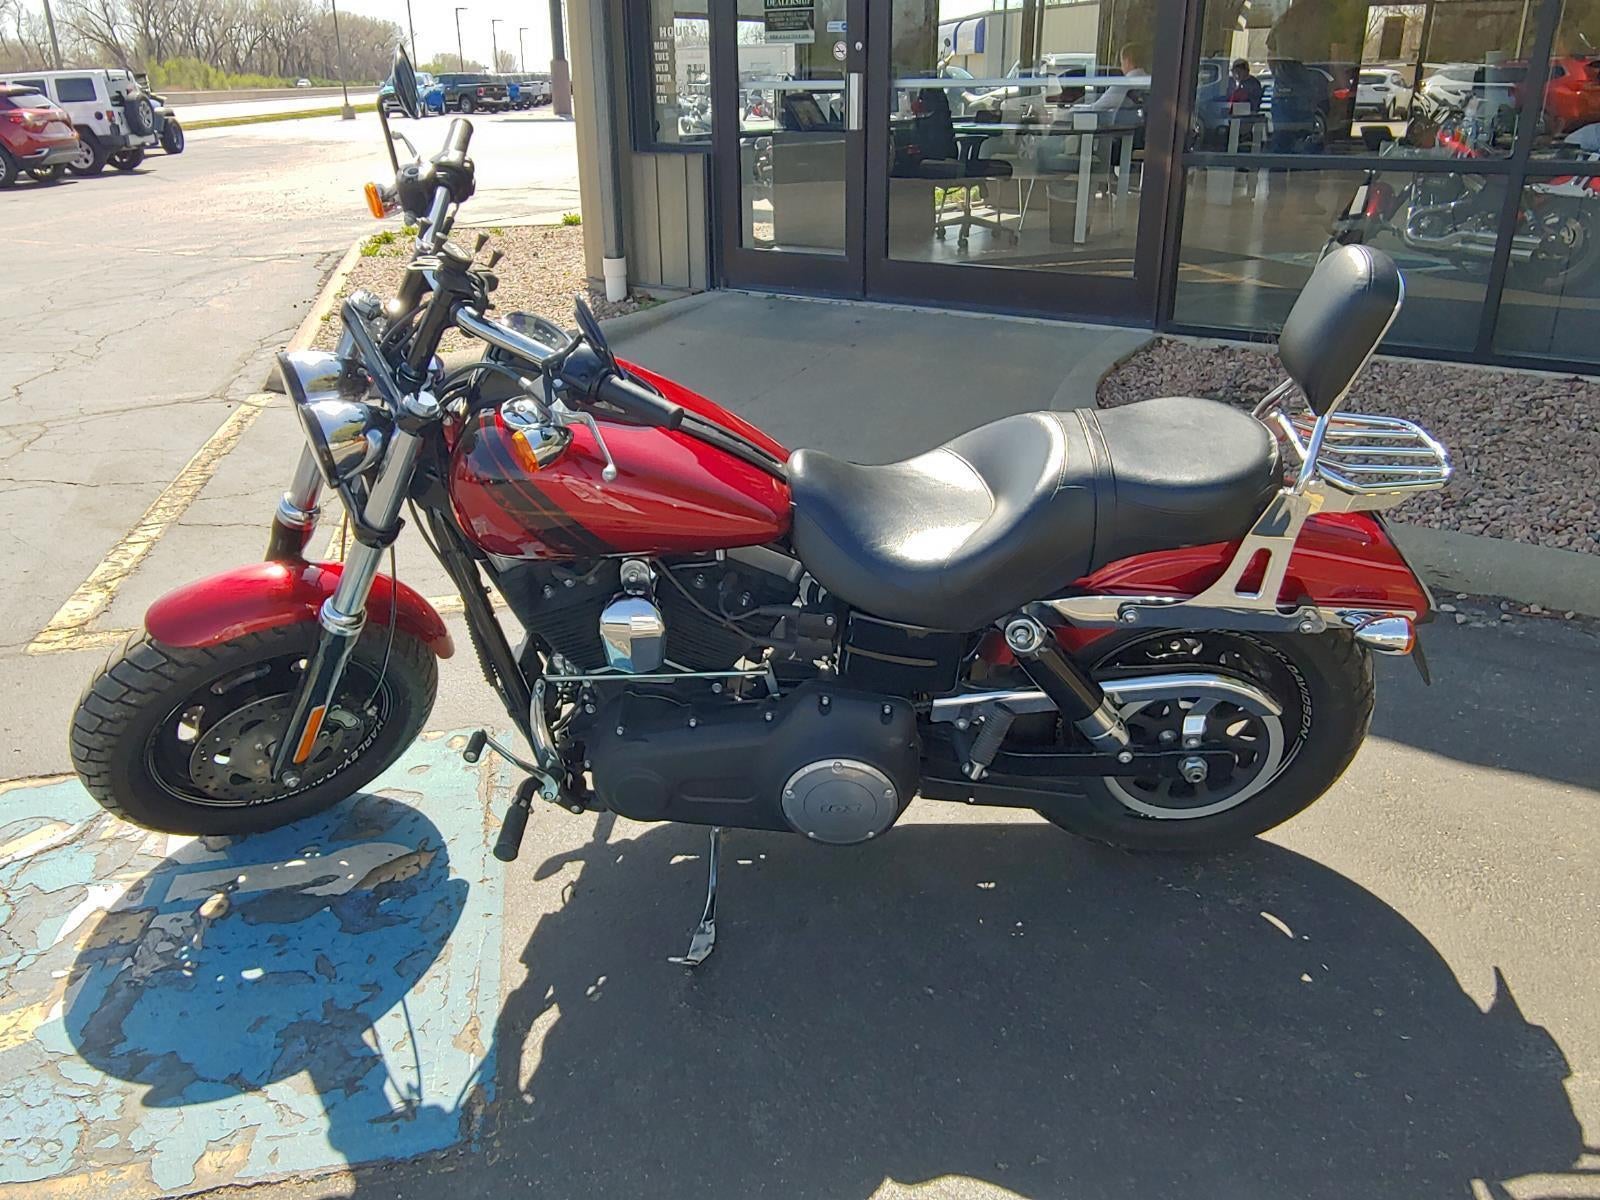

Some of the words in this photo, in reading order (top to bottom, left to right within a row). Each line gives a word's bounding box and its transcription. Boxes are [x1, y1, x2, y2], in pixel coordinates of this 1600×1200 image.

[659, 26, 698, 37] HOURS
[654, 41, 668, 50] MON
[655, 52, 669, 61] TUES
[655, 63, 669, 72] WED
[656, 95, 668, 104] SAT
